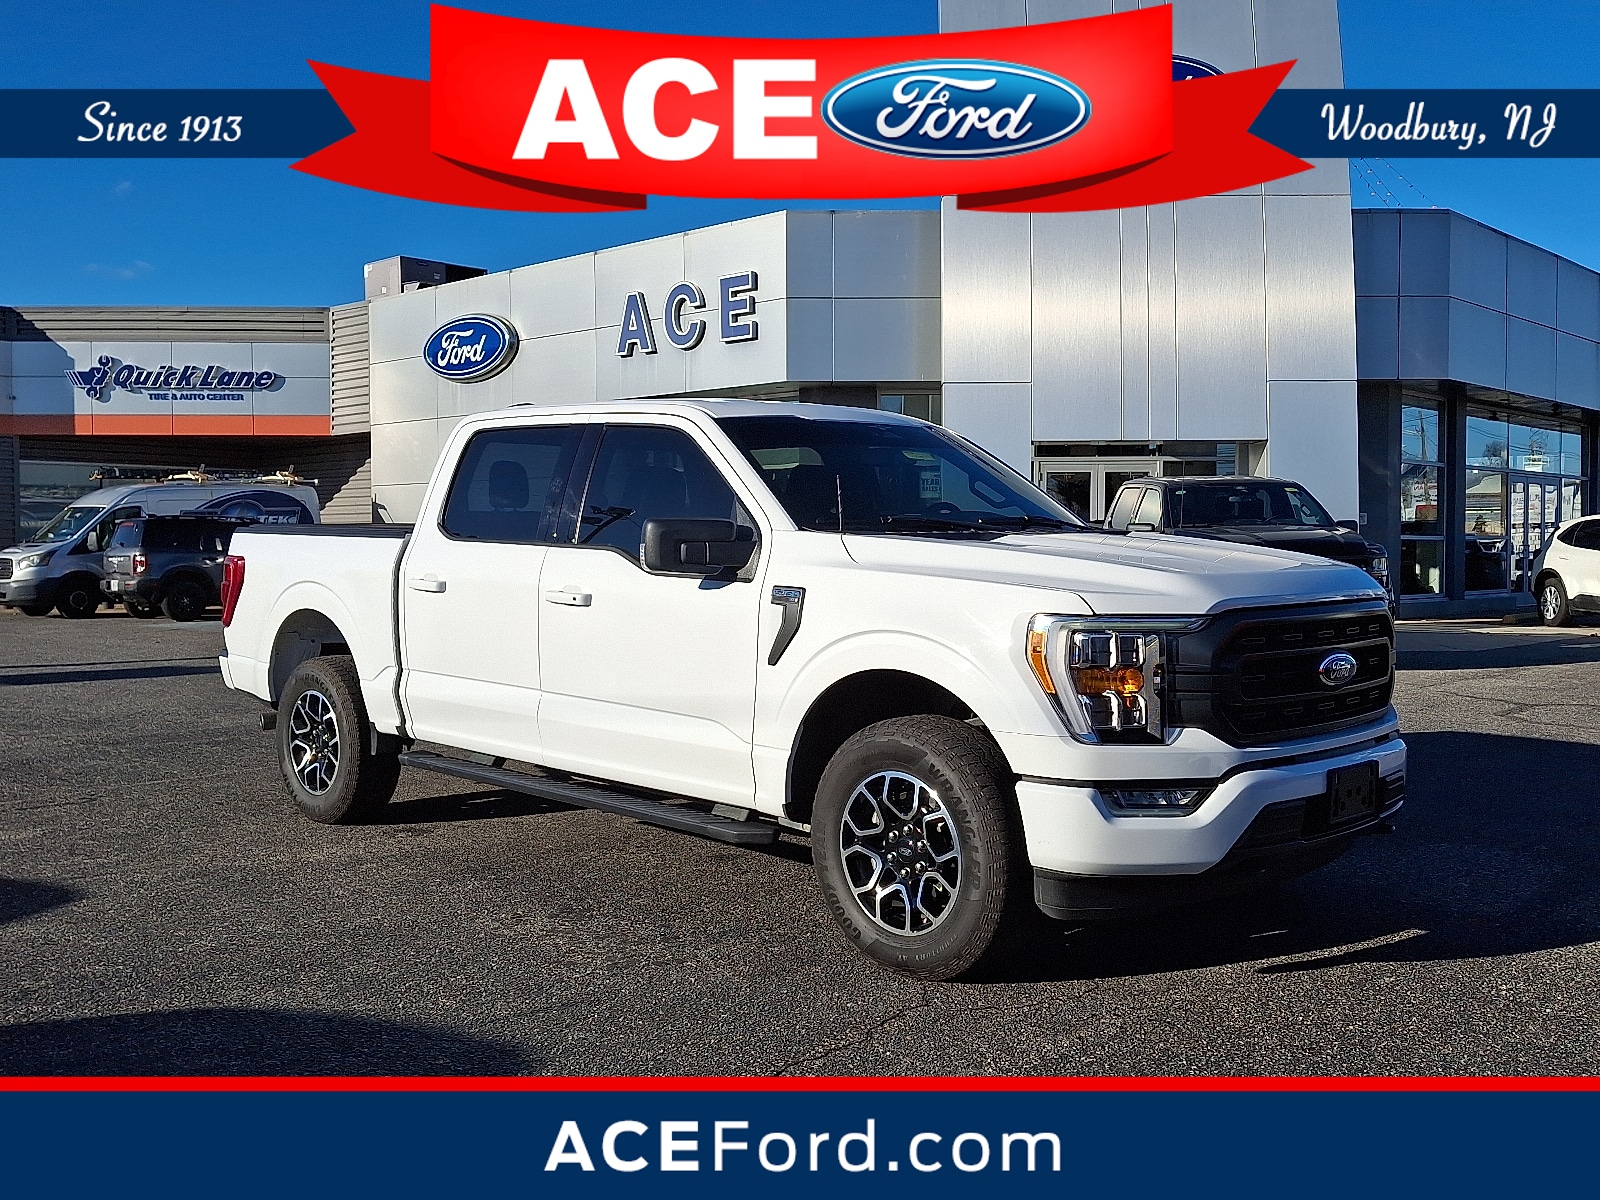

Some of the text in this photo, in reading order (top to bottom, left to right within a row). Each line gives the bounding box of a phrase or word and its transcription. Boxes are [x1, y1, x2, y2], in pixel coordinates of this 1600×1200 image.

[615, 271, 759, 358] ACE
[437, 329, 487, 367] Ford
[113, 364, 275, 389] Quick Lane
